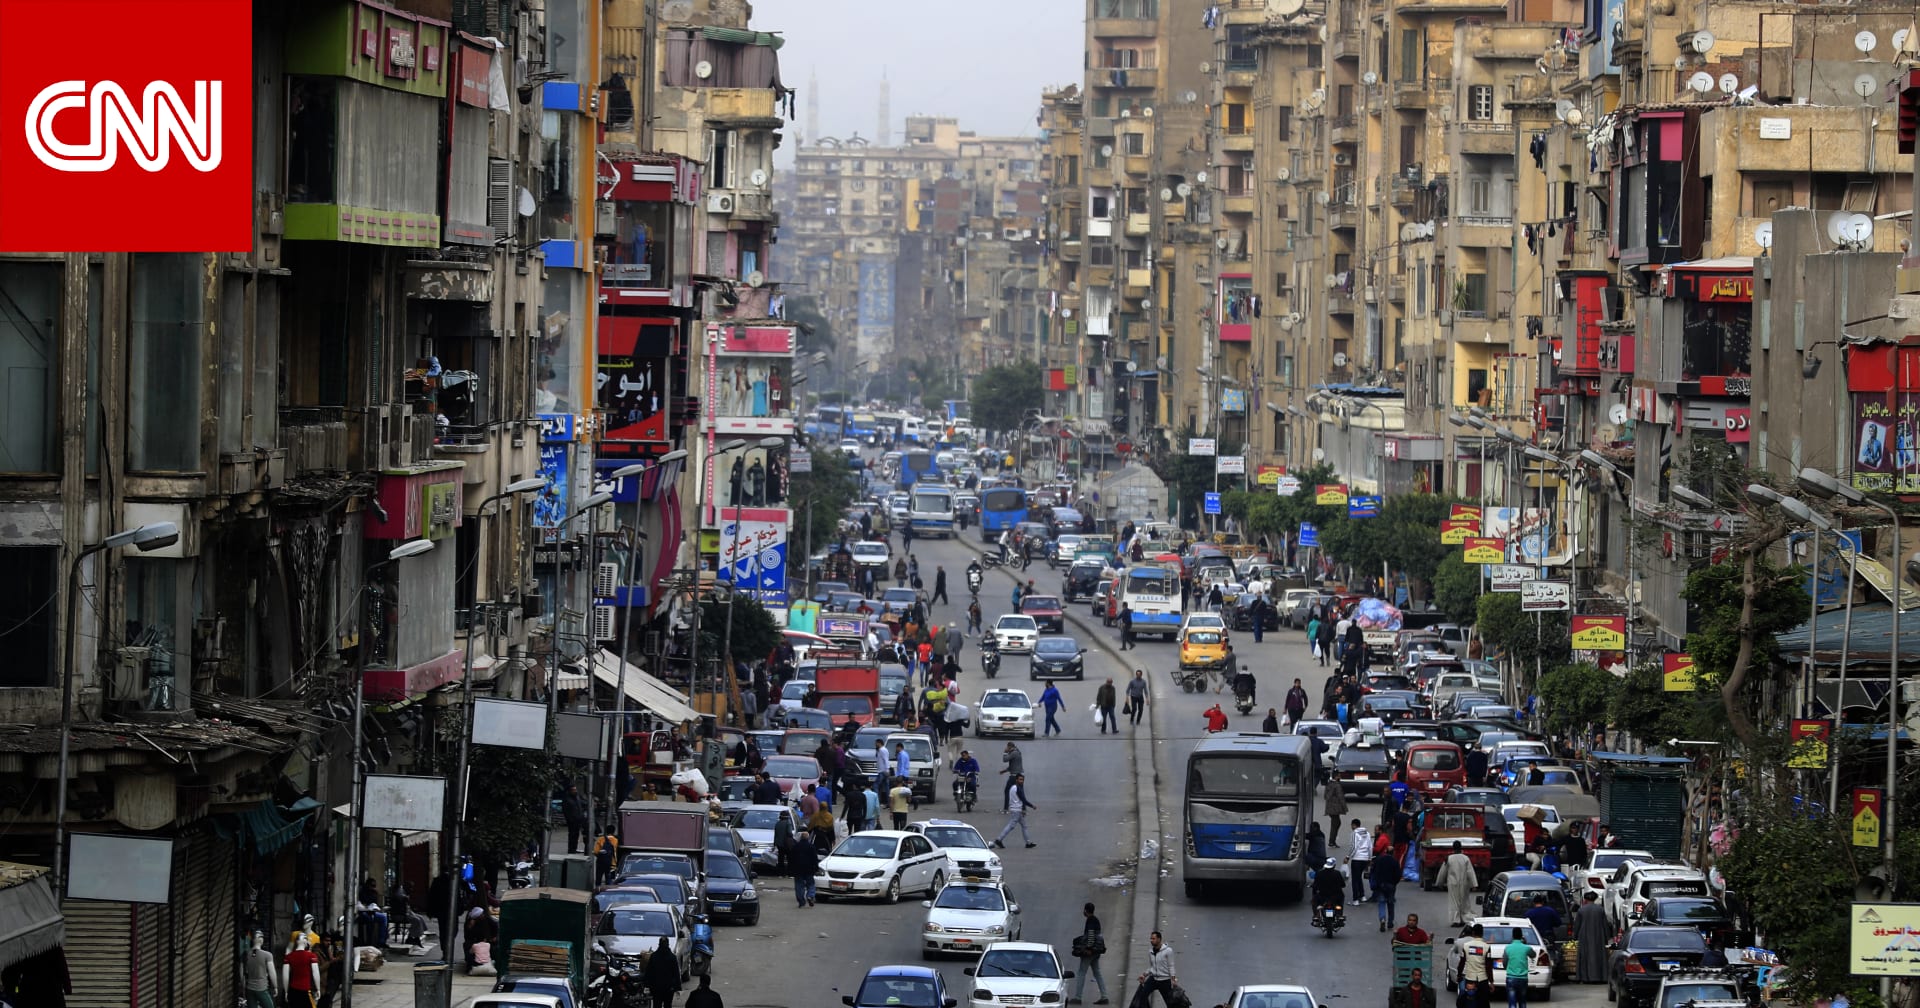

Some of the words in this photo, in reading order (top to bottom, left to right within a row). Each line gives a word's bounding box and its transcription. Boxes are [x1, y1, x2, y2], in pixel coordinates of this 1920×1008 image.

[1523, 589, 1544, 599] راغب
[1546, 587, 1567, 599] أشرف
[1578, 635, 1618, 645] العروسة
[1873, 926, 1905, 936] الشروق
